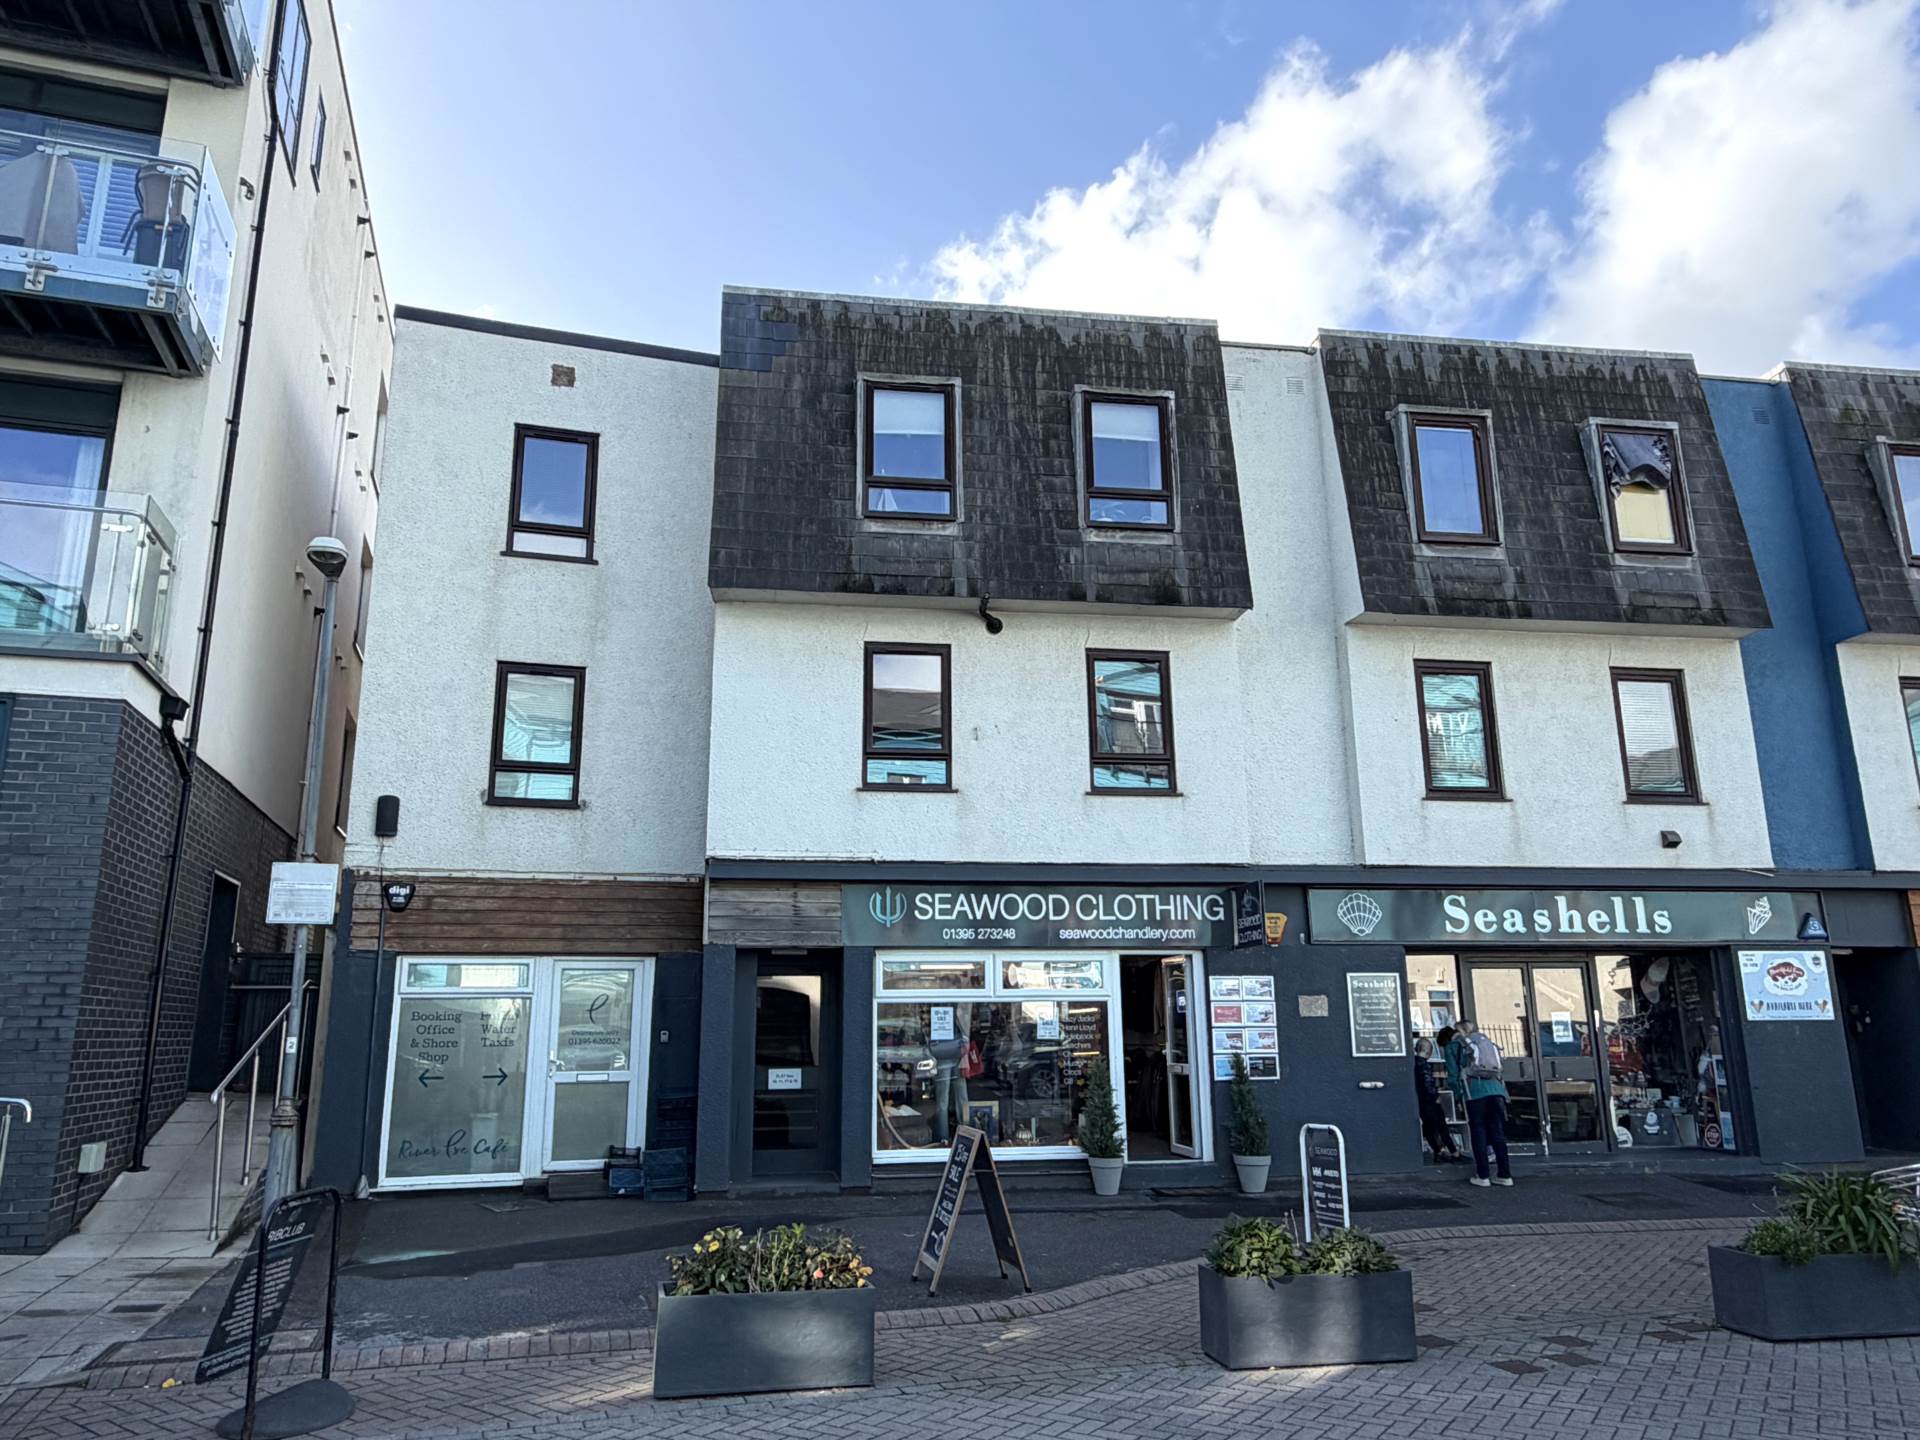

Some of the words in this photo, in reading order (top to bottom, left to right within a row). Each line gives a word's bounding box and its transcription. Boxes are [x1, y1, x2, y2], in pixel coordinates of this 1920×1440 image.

[388, 885, 410, 895] digi
[914, 893, 1069, 921] SEAWOOD
[1075, 893, 1225, 921] CLOTHING
[1443, 894, 1673, 934] Seashells
[942, 928, 975, 940] 01395
[977, 928, 1016, 940] 273248
[1058, 928, 1196, 942] seawoodchandlery.com
[1352, 980, 1395, 988] Seashells
[411, 1011, 462, 1023] Booking
[416, 1024, 455, 1034] Office
[288, 1041, 295, 1050] 2
[410, 1039, 420, 1048] &
[422, 1038, 459, 1048] Shore
[480, 1037, 514, 1048] Taxis
[418, 1052, 449, 1064] Shop
